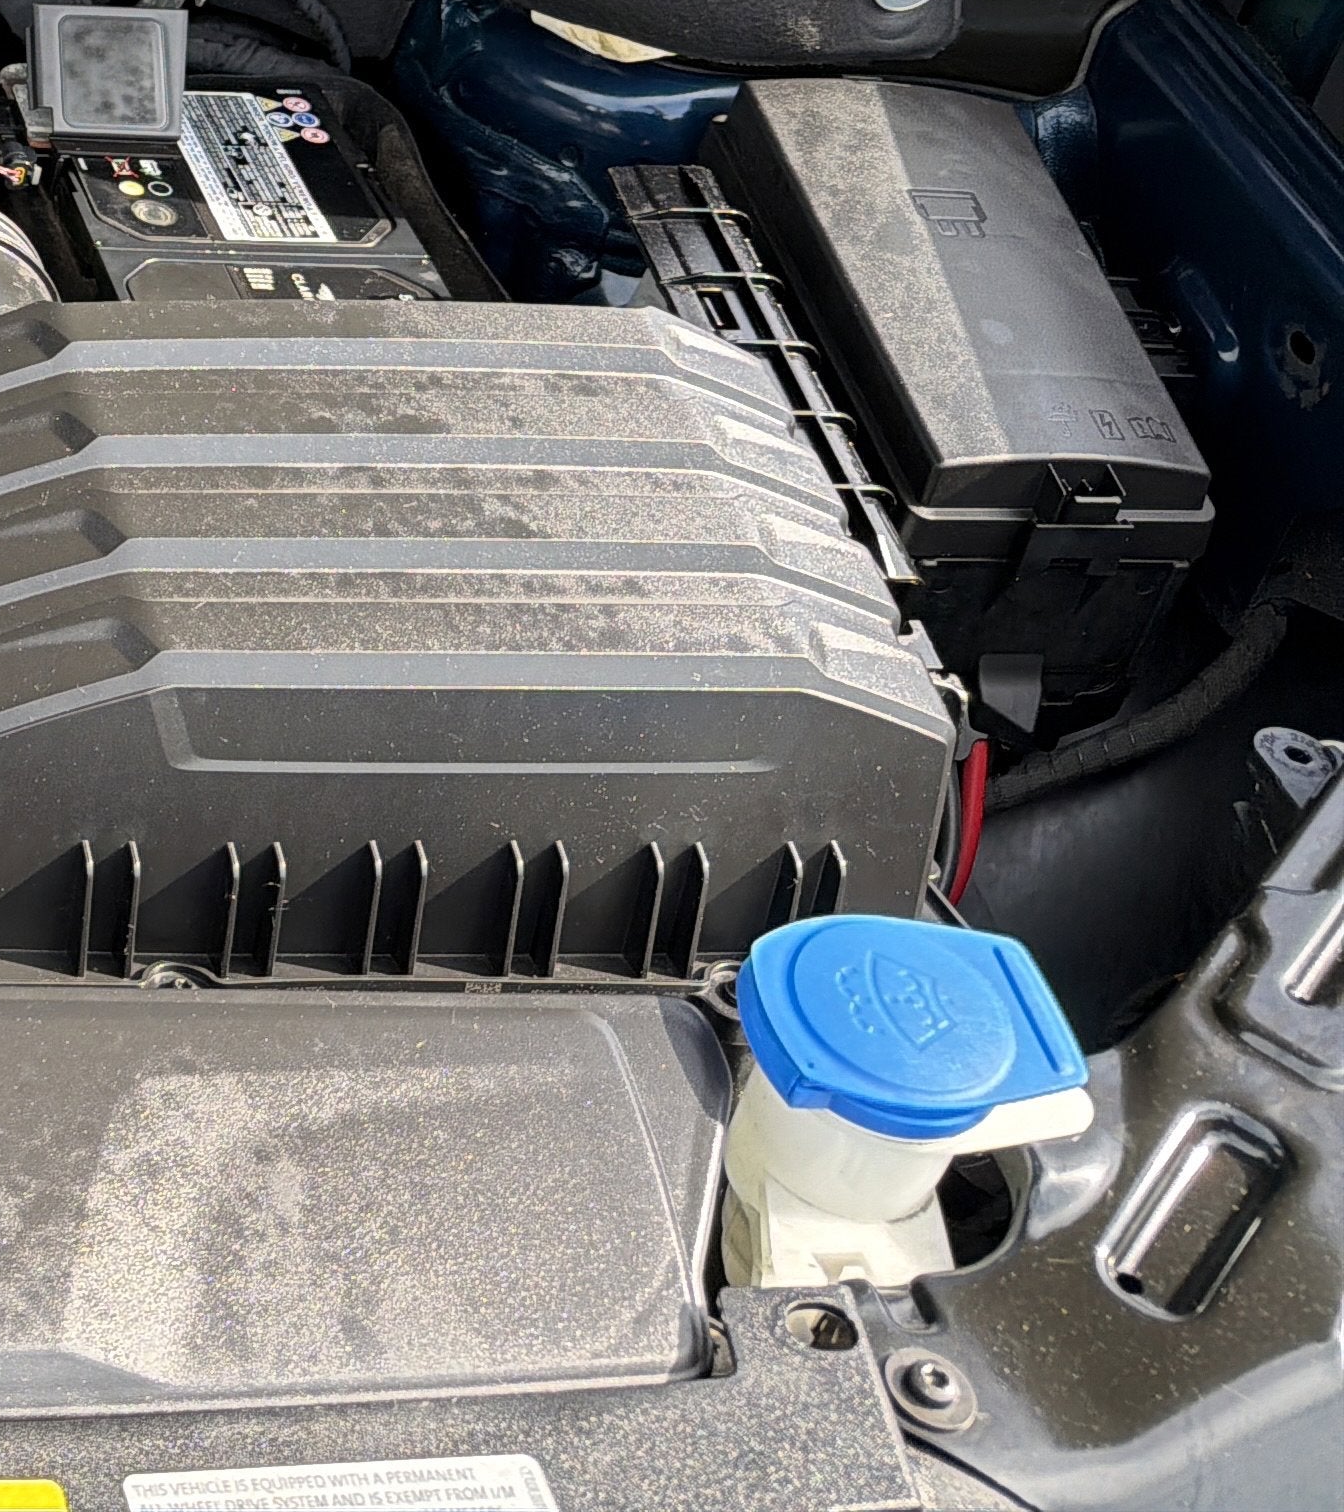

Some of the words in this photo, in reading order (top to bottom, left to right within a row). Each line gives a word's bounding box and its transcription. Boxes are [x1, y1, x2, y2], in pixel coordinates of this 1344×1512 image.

[131, 1484, 168, 1498] THIS
[169, 1479, 232, 1495] VEHICLE
[234, 1478, 248, 1493] IS
[252, 1475, 326, 1492] EQUIPPED
[326, 1473, 370, 1487] WITH
[373, 1472, 385, 1485] A
[386, 1467, 477, 1484] PERMANENT
[272, 1494, 329, 1509] SYSTEM
[331, 1492, 367, 1507] AND
[368, 1491, 384, 1506] IS
[385, 1488, 442, 1505] EXEMPT
[445, 1486, 488, 1501] FROM
